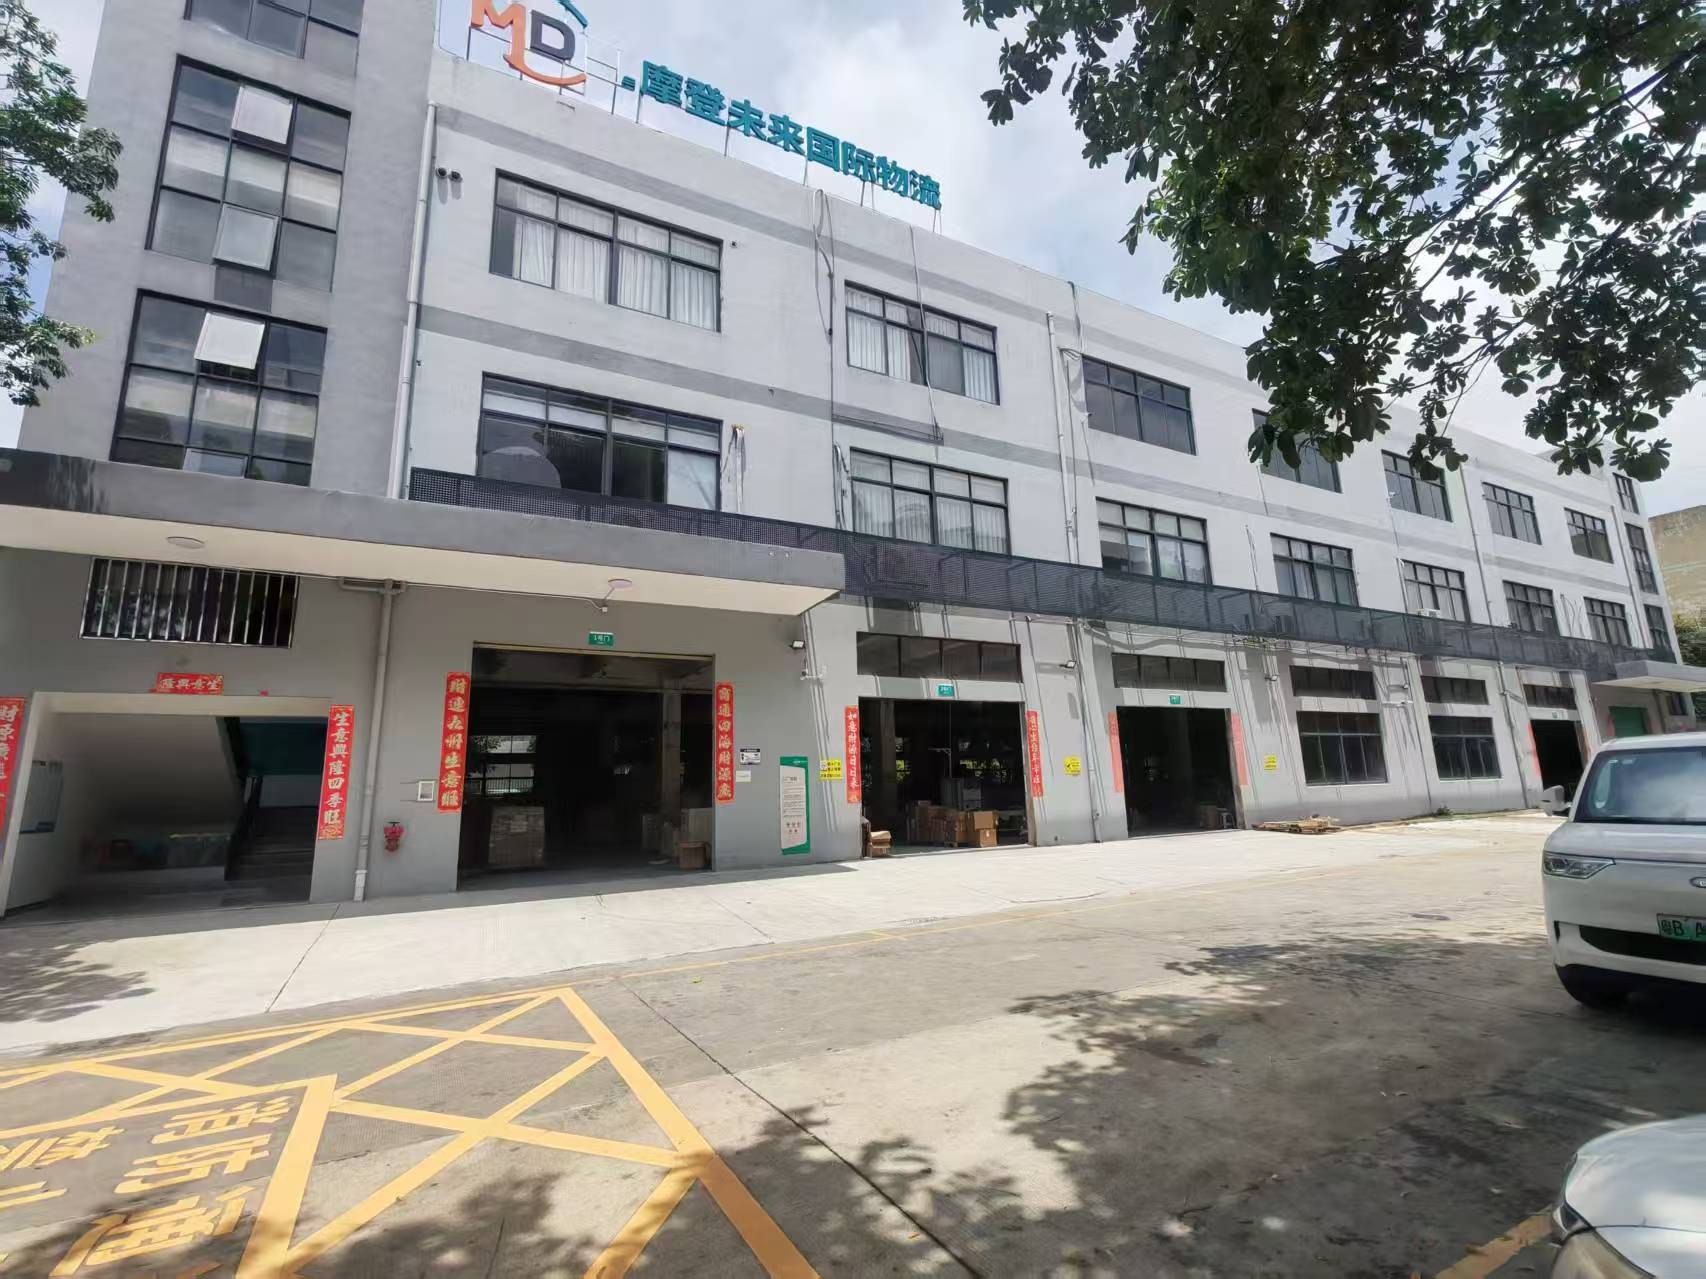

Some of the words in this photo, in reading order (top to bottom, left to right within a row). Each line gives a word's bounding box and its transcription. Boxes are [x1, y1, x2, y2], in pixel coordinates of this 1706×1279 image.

[641, 60, 942, 210] 摩登未来国际物流
[48, 1096, 292, 1279] 消防通
